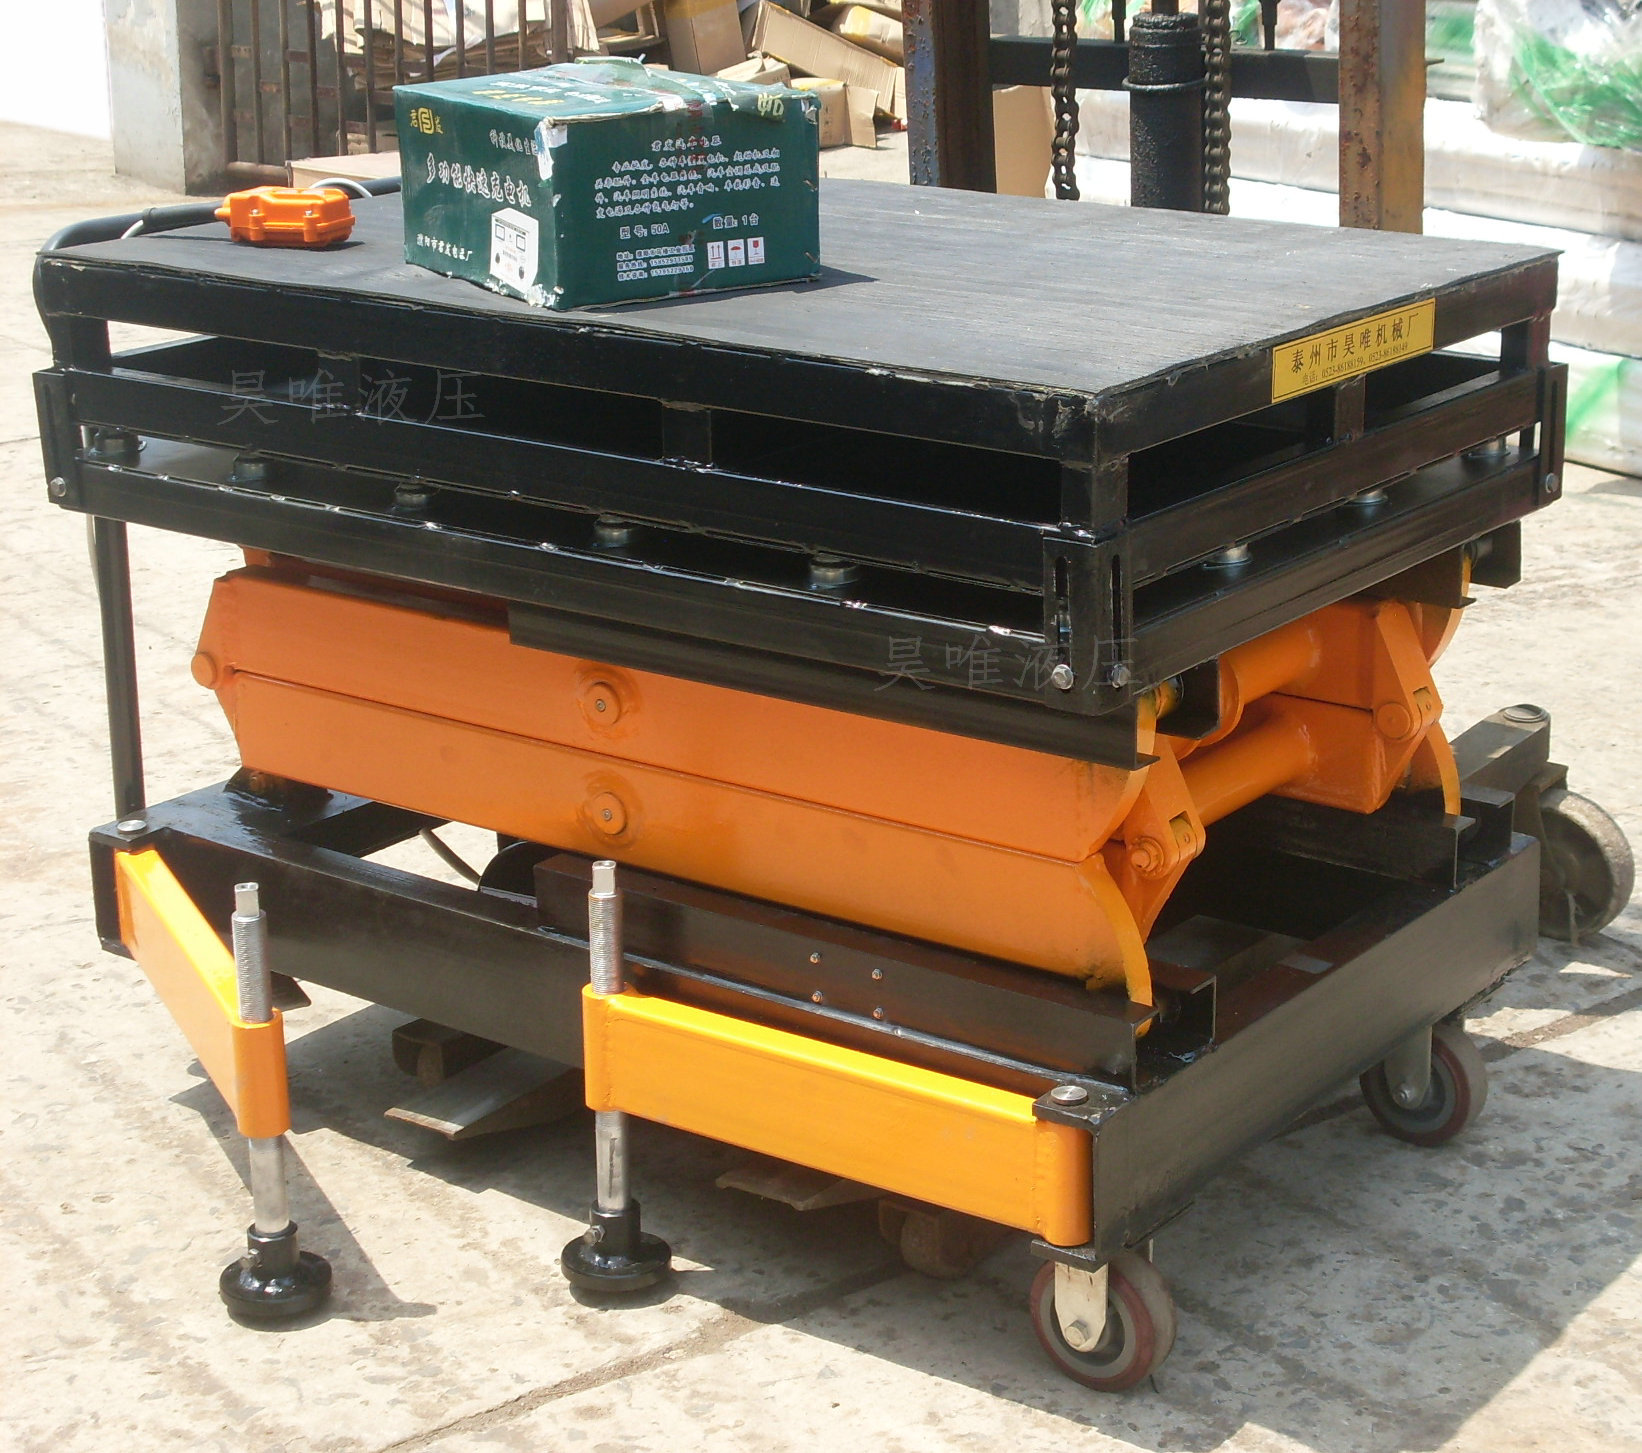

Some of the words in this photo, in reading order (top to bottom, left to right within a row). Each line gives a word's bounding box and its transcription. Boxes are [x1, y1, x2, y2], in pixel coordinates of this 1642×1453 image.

[426, 151, 532, 208] 多功能快速充电机
[1290, 312, 1419, 374] 泰州市昊唯机械厂
